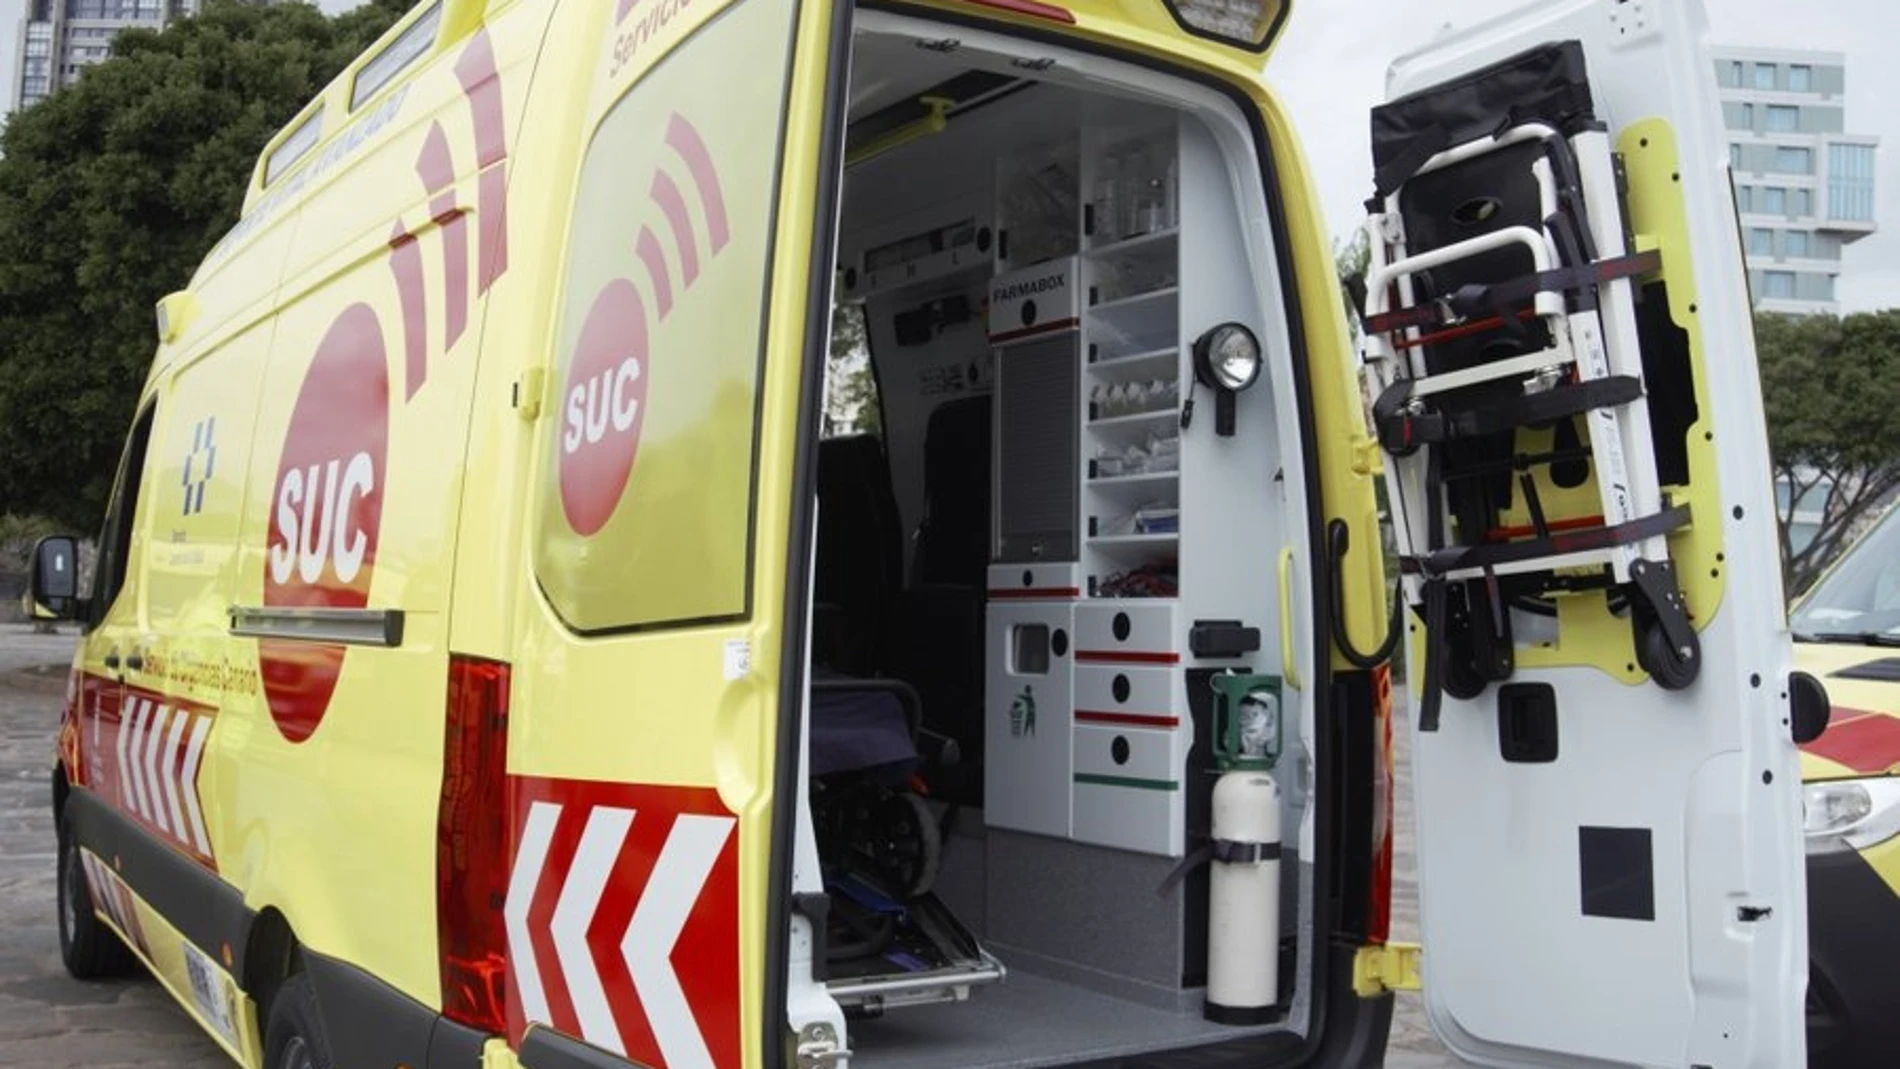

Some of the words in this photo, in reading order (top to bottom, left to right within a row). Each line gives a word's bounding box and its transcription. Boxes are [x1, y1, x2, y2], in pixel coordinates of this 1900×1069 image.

[993, 274, 1065, 303] FARMABOX
[564, 356, 641, 454] SUC
[271, 451, 374, 585] SUC
